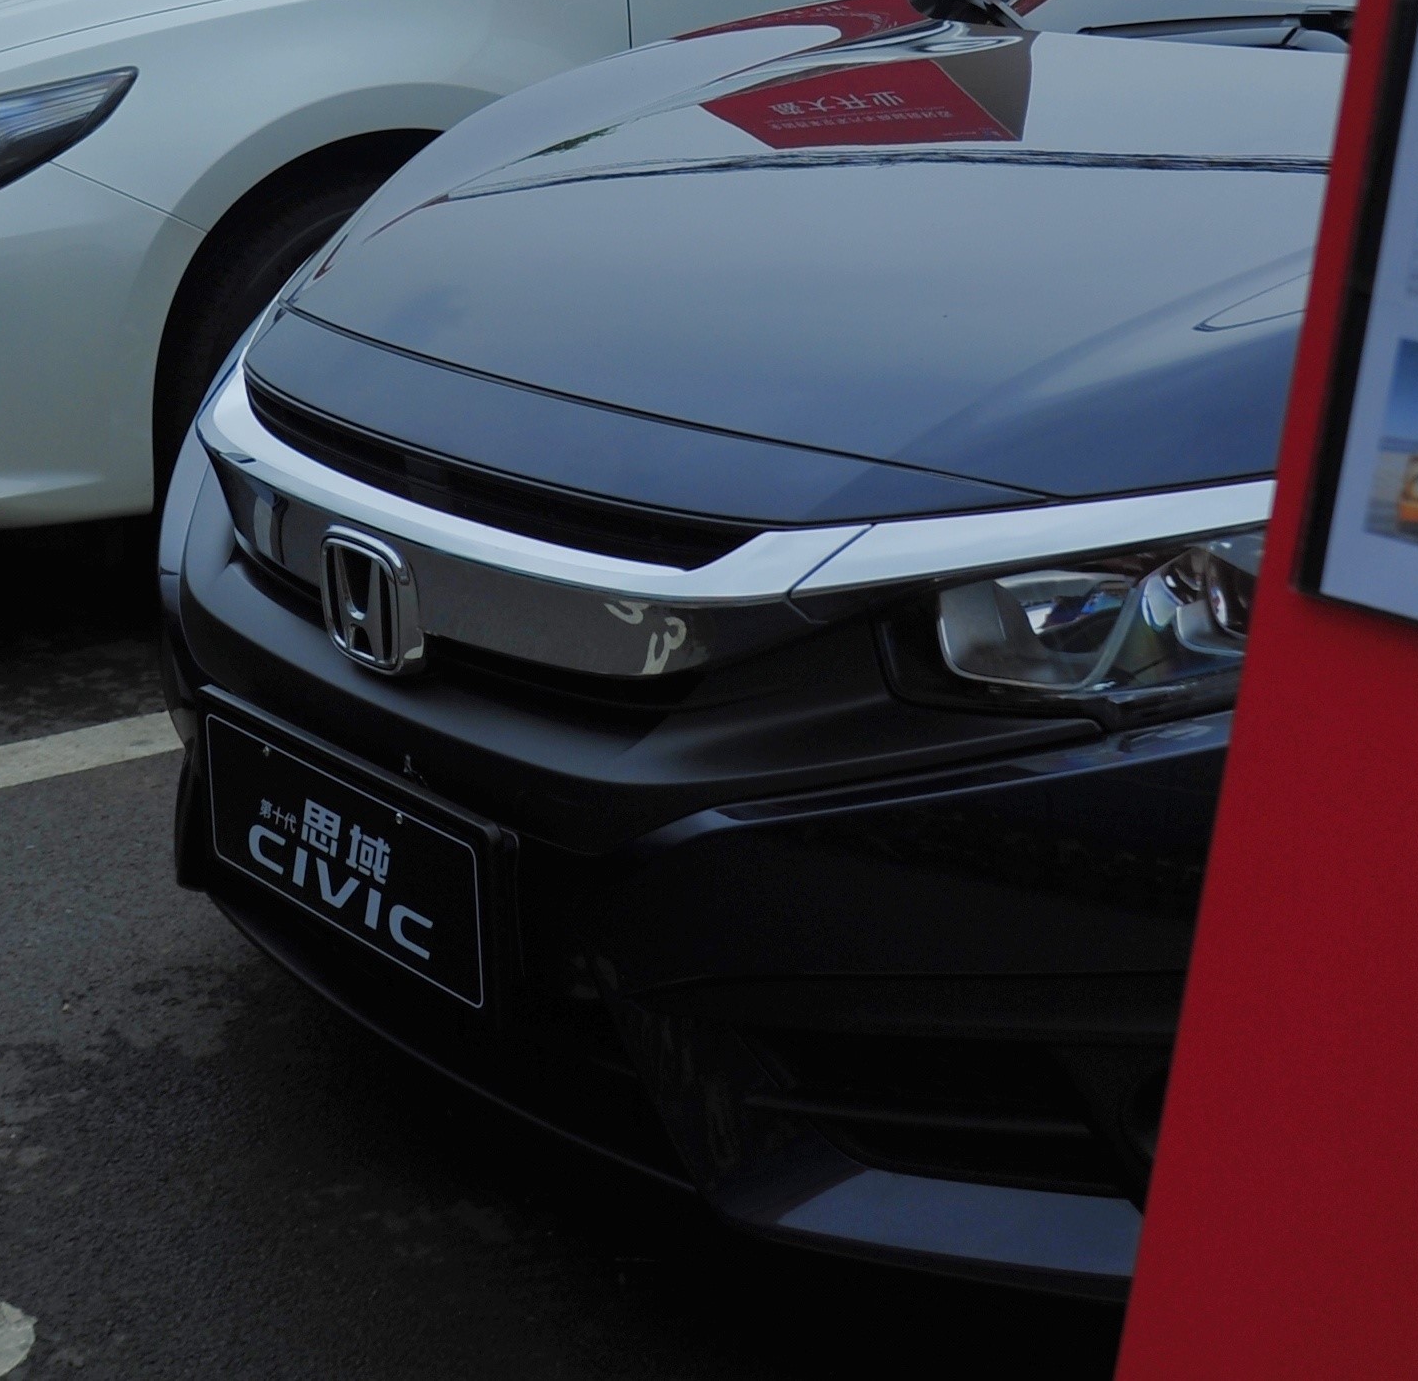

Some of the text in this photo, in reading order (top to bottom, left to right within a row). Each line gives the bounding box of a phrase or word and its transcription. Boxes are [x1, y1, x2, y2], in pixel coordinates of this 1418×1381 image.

[248, 824, 434, 961] CIVIC
[259, 797, 392, 885] 第十代 思域
